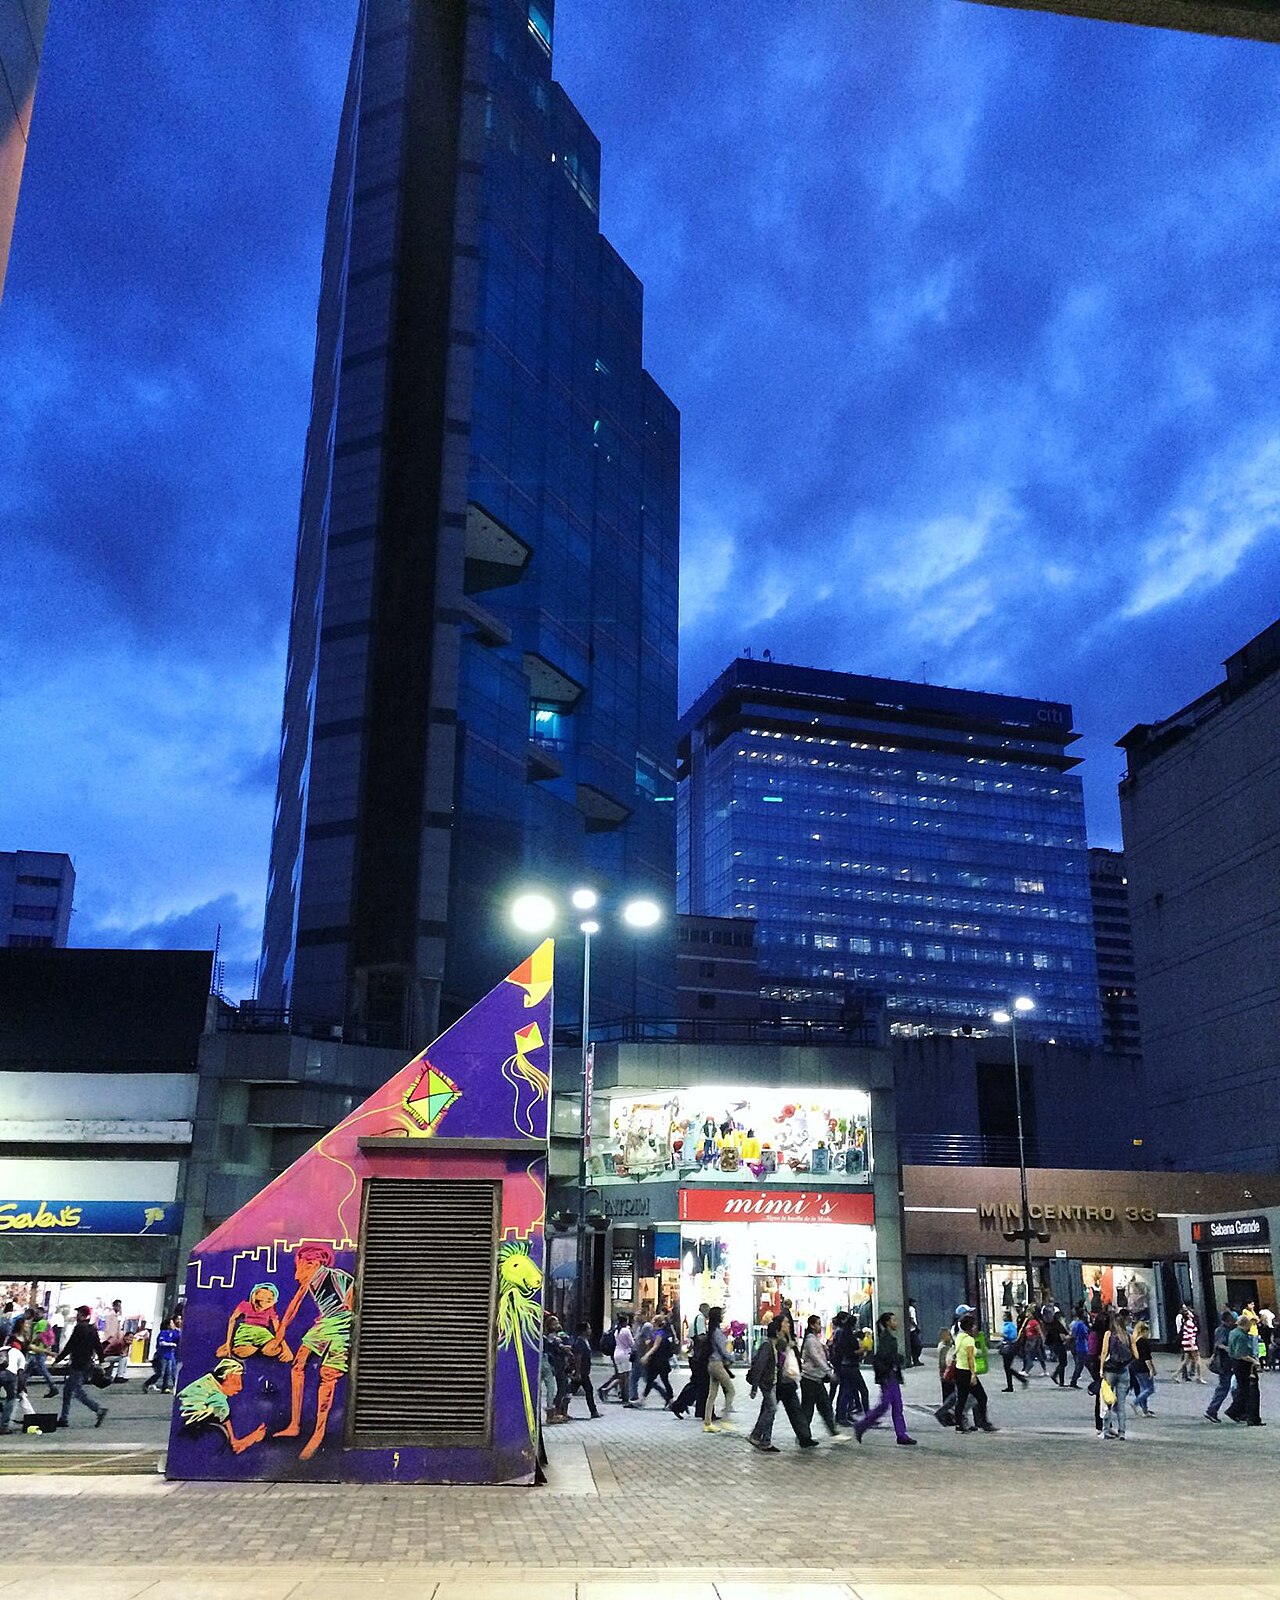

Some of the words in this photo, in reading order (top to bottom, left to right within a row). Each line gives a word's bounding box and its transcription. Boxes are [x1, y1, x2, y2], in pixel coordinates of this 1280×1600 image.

[1037, 709, 1063, 724] citi
[723, 1193, 839, 1215] mimi's
[980, 1203, 1115, 1221] MINCENTRO
[1125, 1206, 1156, 1222] 33
[0, 1201, 83, 1231] Seven's
[1210, 1222, 1235, 1237] Sabana
[1235, 1220, 1261, 1235] Grande
